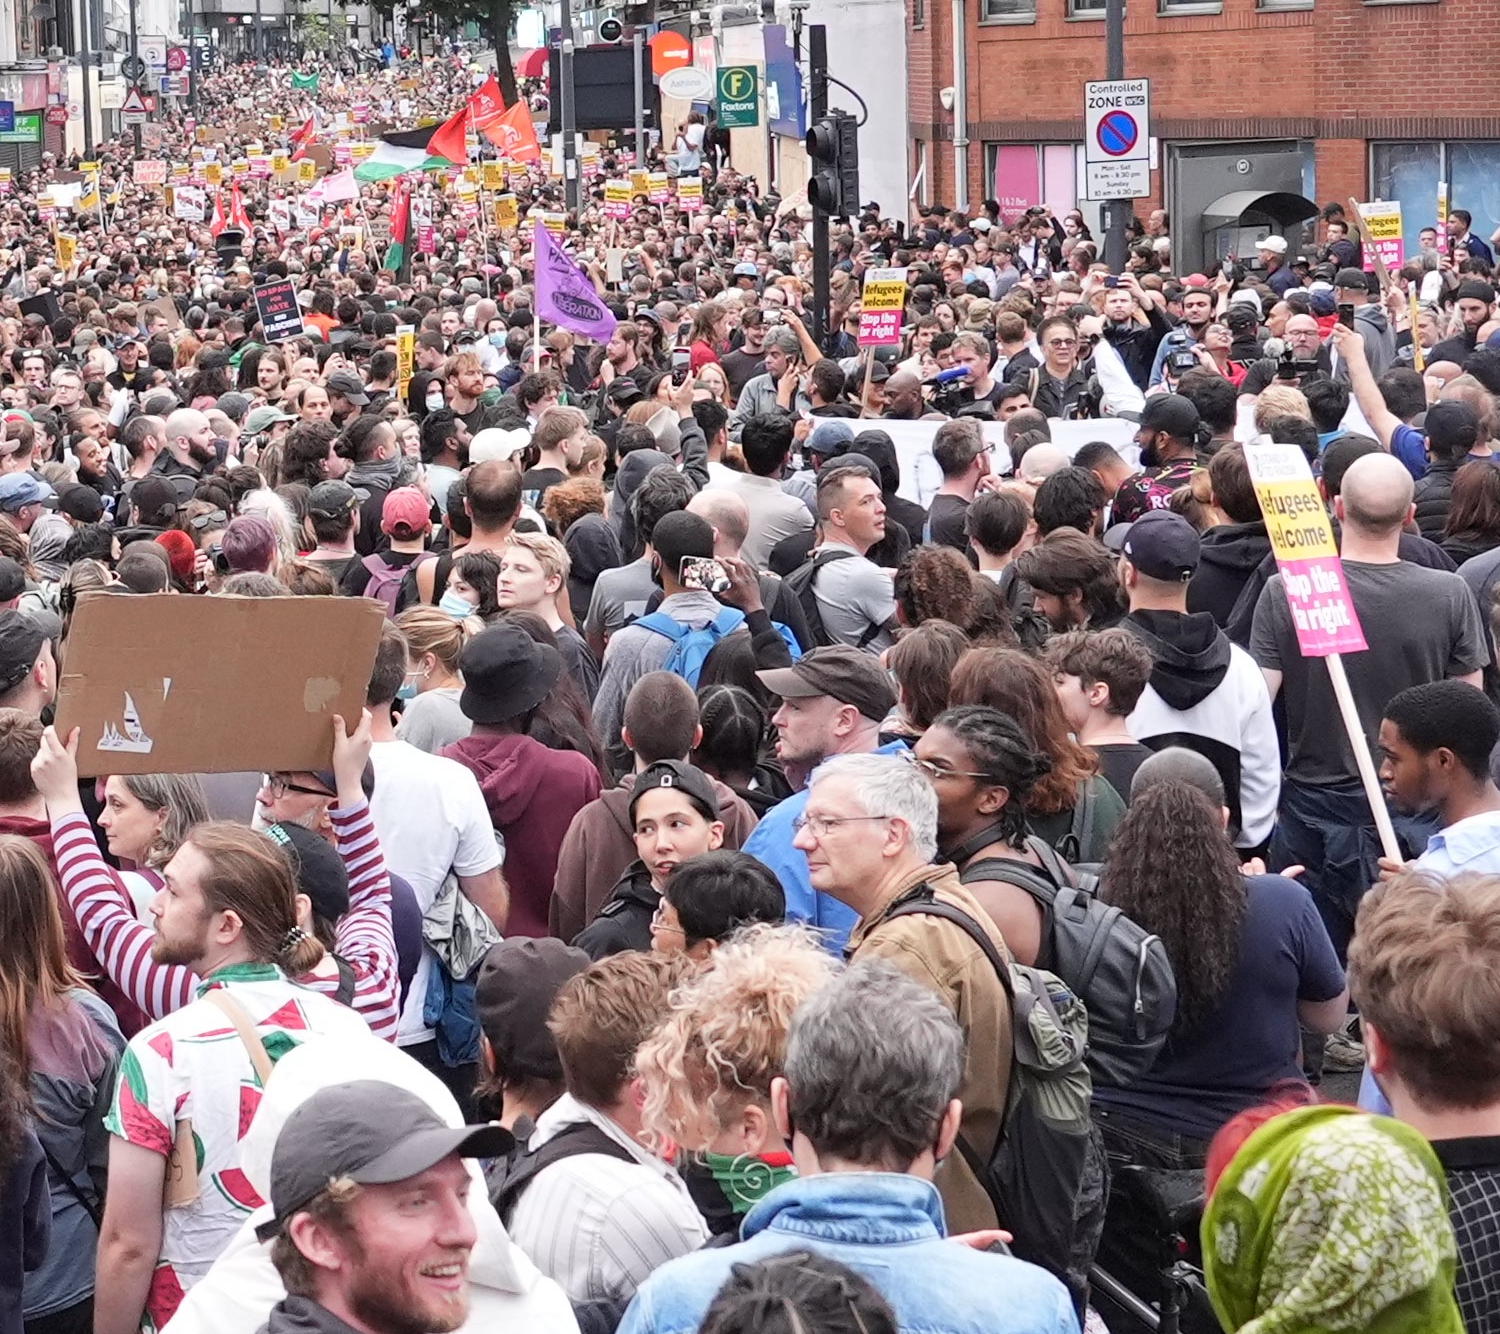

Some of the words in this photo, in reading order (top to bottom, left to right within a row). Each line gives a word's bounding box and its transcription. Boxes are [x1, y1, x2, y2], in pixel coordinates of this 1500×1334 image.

[1089, 83, 1143, 94] Controlled
[720, 101, 755, 112] Foxtons
[1088, 96, 1122, 109] ZONE
[865, 284, 903, 296] Refugees
[553, 291, 602, 321] LIBERATION
[864, 297, 900, 307] welcome
[861, 312, 880, 327] Stop
[880, 312, 896, 324] the
[859, 326, 871, 337] far
[872, 325, 895, 339] right
[1310, 564, 1341, 594] the
[1310, 598, 1351, 635] right
